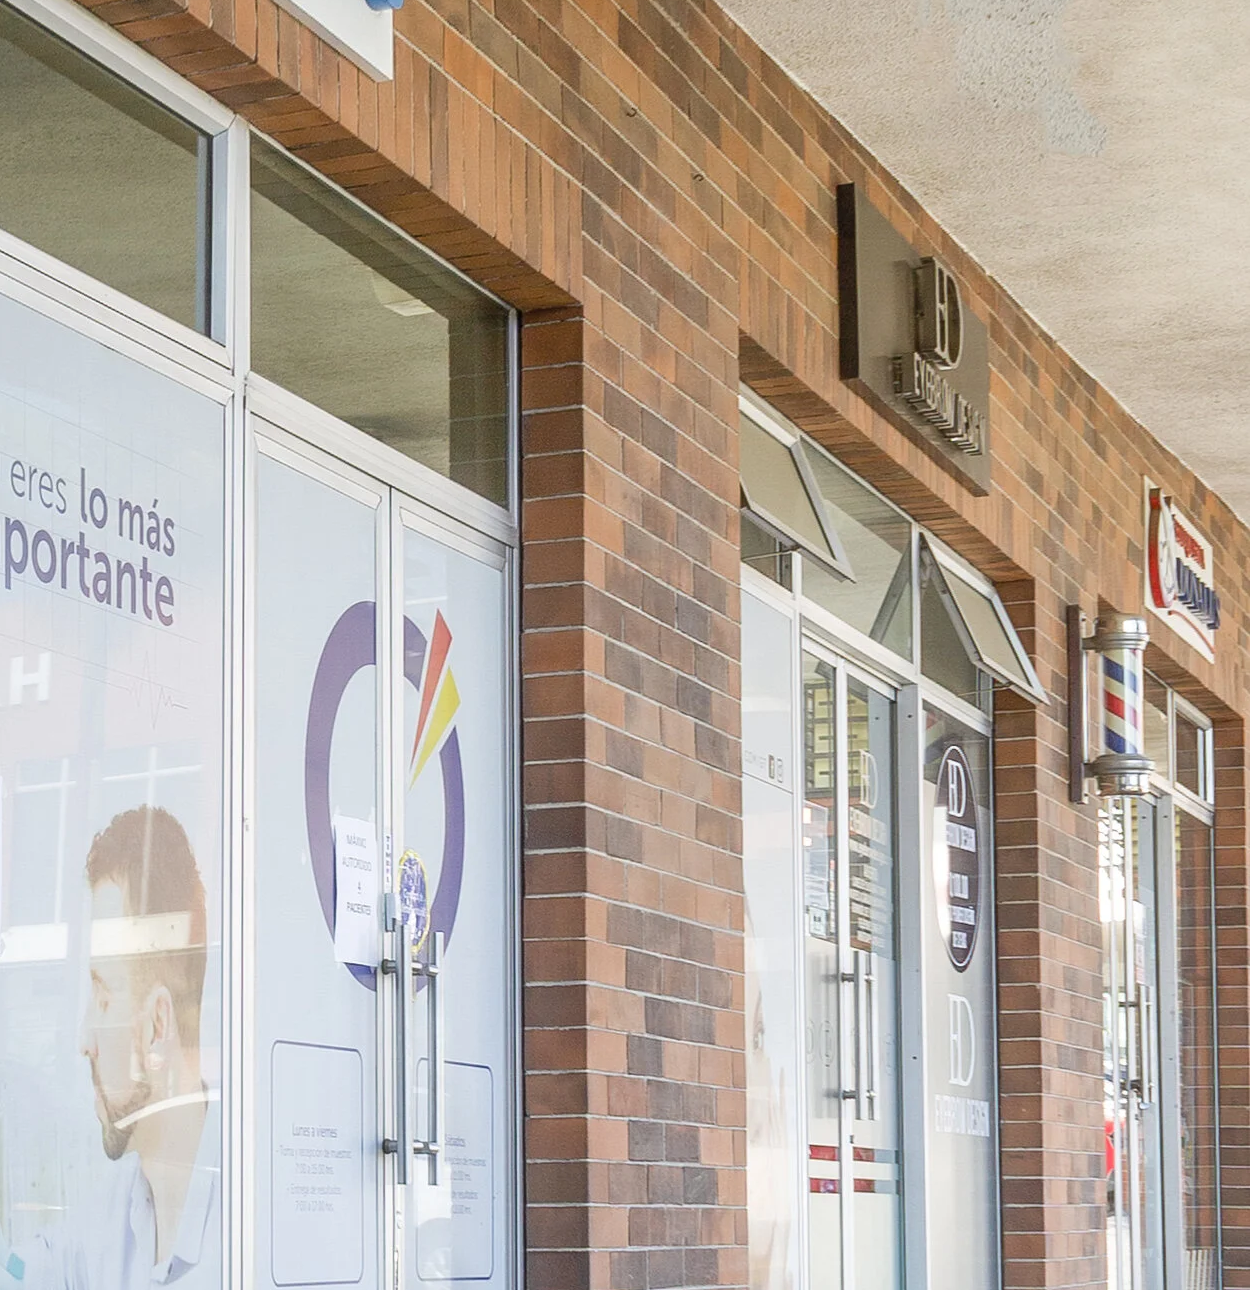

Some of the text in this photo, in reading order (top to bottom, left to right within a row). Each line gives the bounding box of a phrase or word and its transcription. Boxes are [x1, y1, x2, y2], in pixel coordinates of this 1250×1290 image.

[10, 458, 68, 515] eres
[81, 467, 109, 530] lo
[118, 497, 176, 557] más
